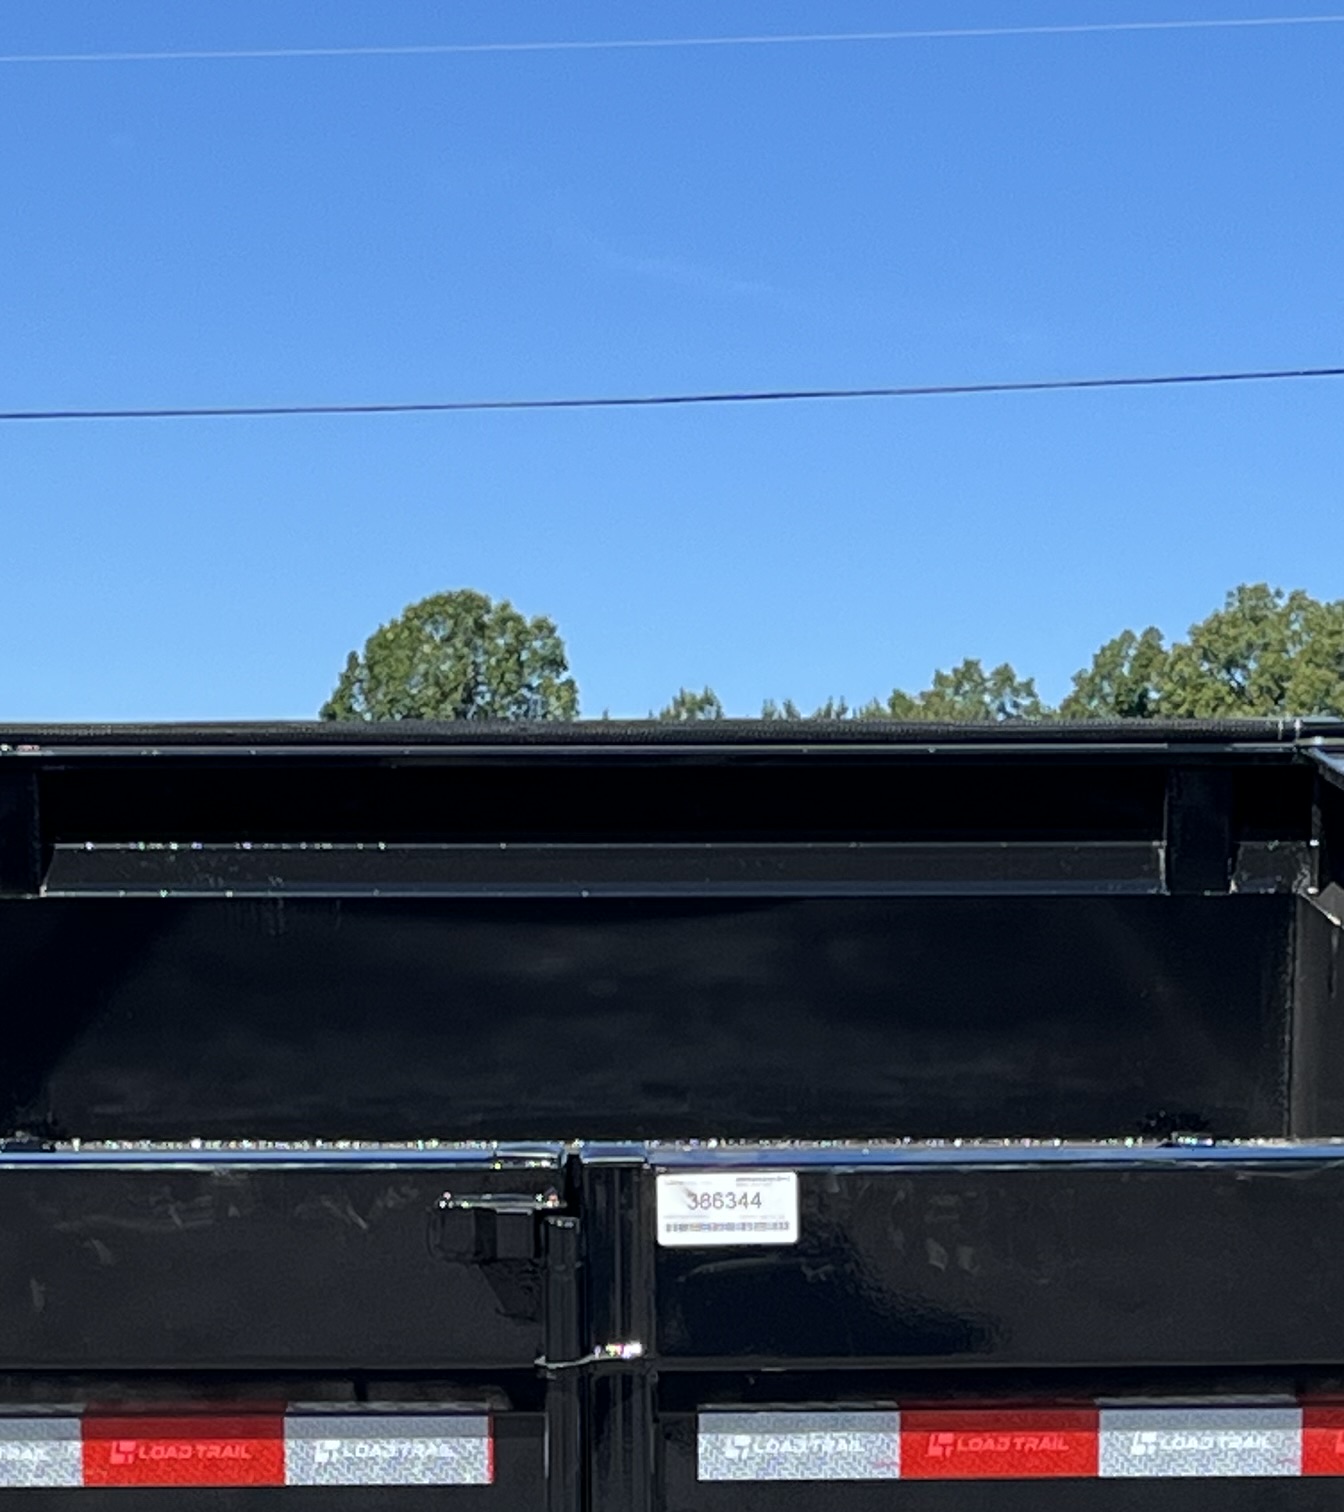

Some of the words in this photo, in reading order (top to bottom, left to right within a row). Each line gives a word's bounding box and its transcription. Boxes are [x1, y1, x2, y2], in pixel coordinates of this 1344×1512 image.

[957, 1437, 1011, 1451] LOAD
[1013, 1436, 1069, 1451] TRAIL
[138, 1445, 193, 1460] LOAD
[196, 1444, 253, 1460] TRAIL
